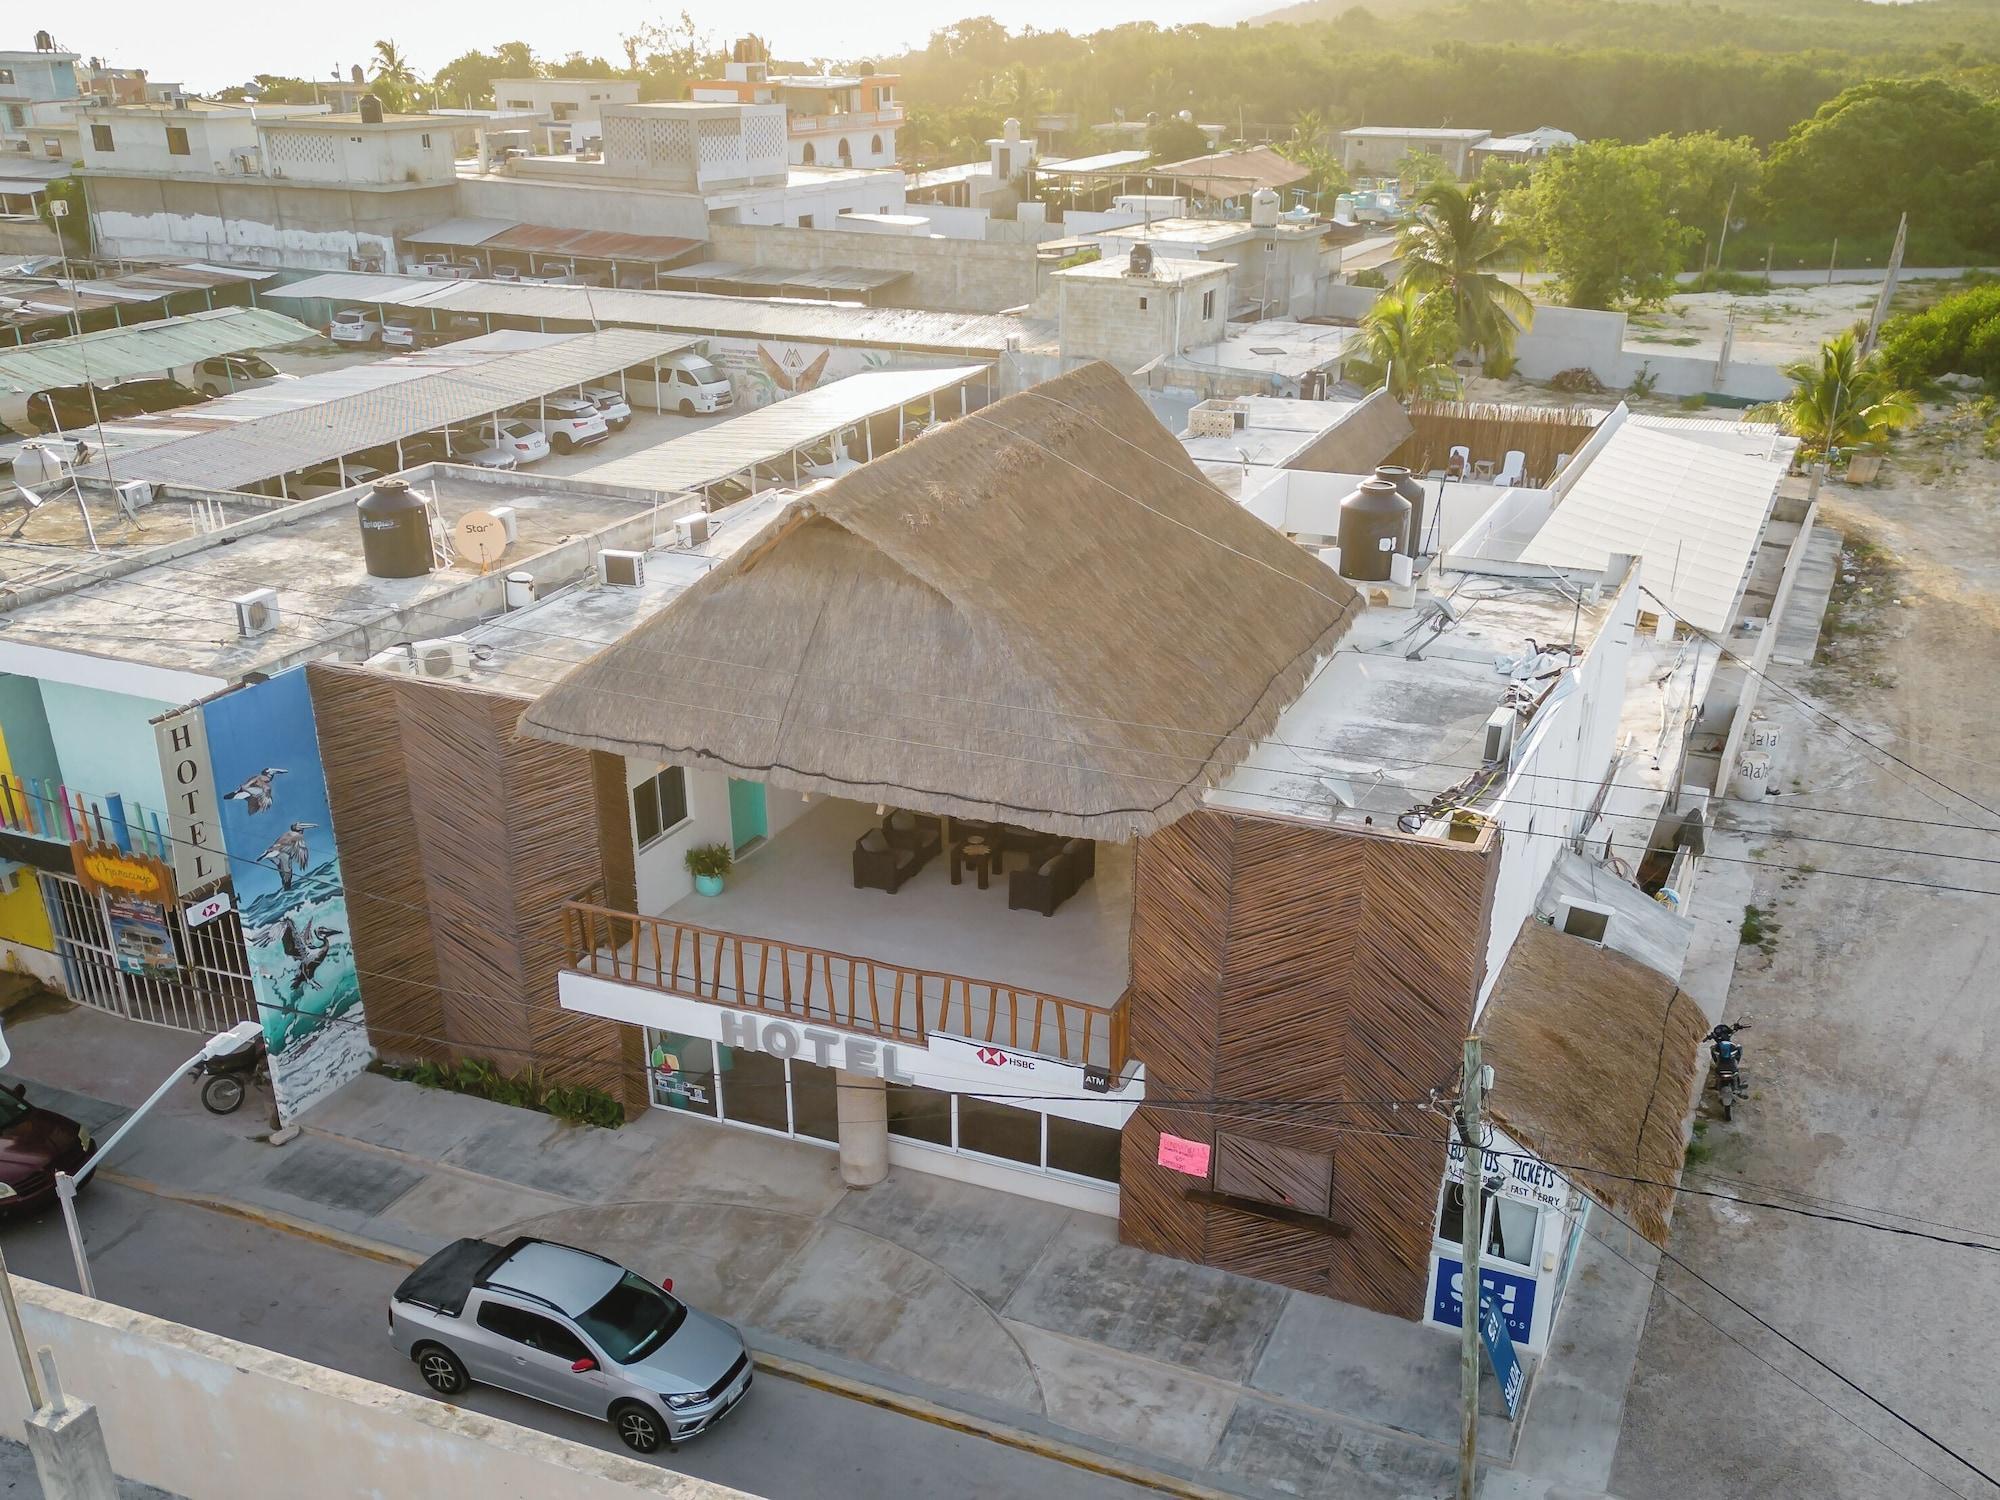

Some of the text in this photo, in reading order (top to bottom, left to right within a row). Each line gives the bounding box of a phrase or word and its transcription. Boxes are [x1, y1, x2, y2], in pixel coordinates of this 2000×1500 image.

[465, 523, 489, 534] Star
[170, 724, 213, 879] HOTEL
[720, 1010, 915, 1087] HOTEL
[1008, 1057, 1035, 1070] HSBC
[1085, 1075, 1105, 1086] ATM
[1511, 1157, 1555, 1189] TICKETS
[1510, 1184, 1529, 1197] FAST
